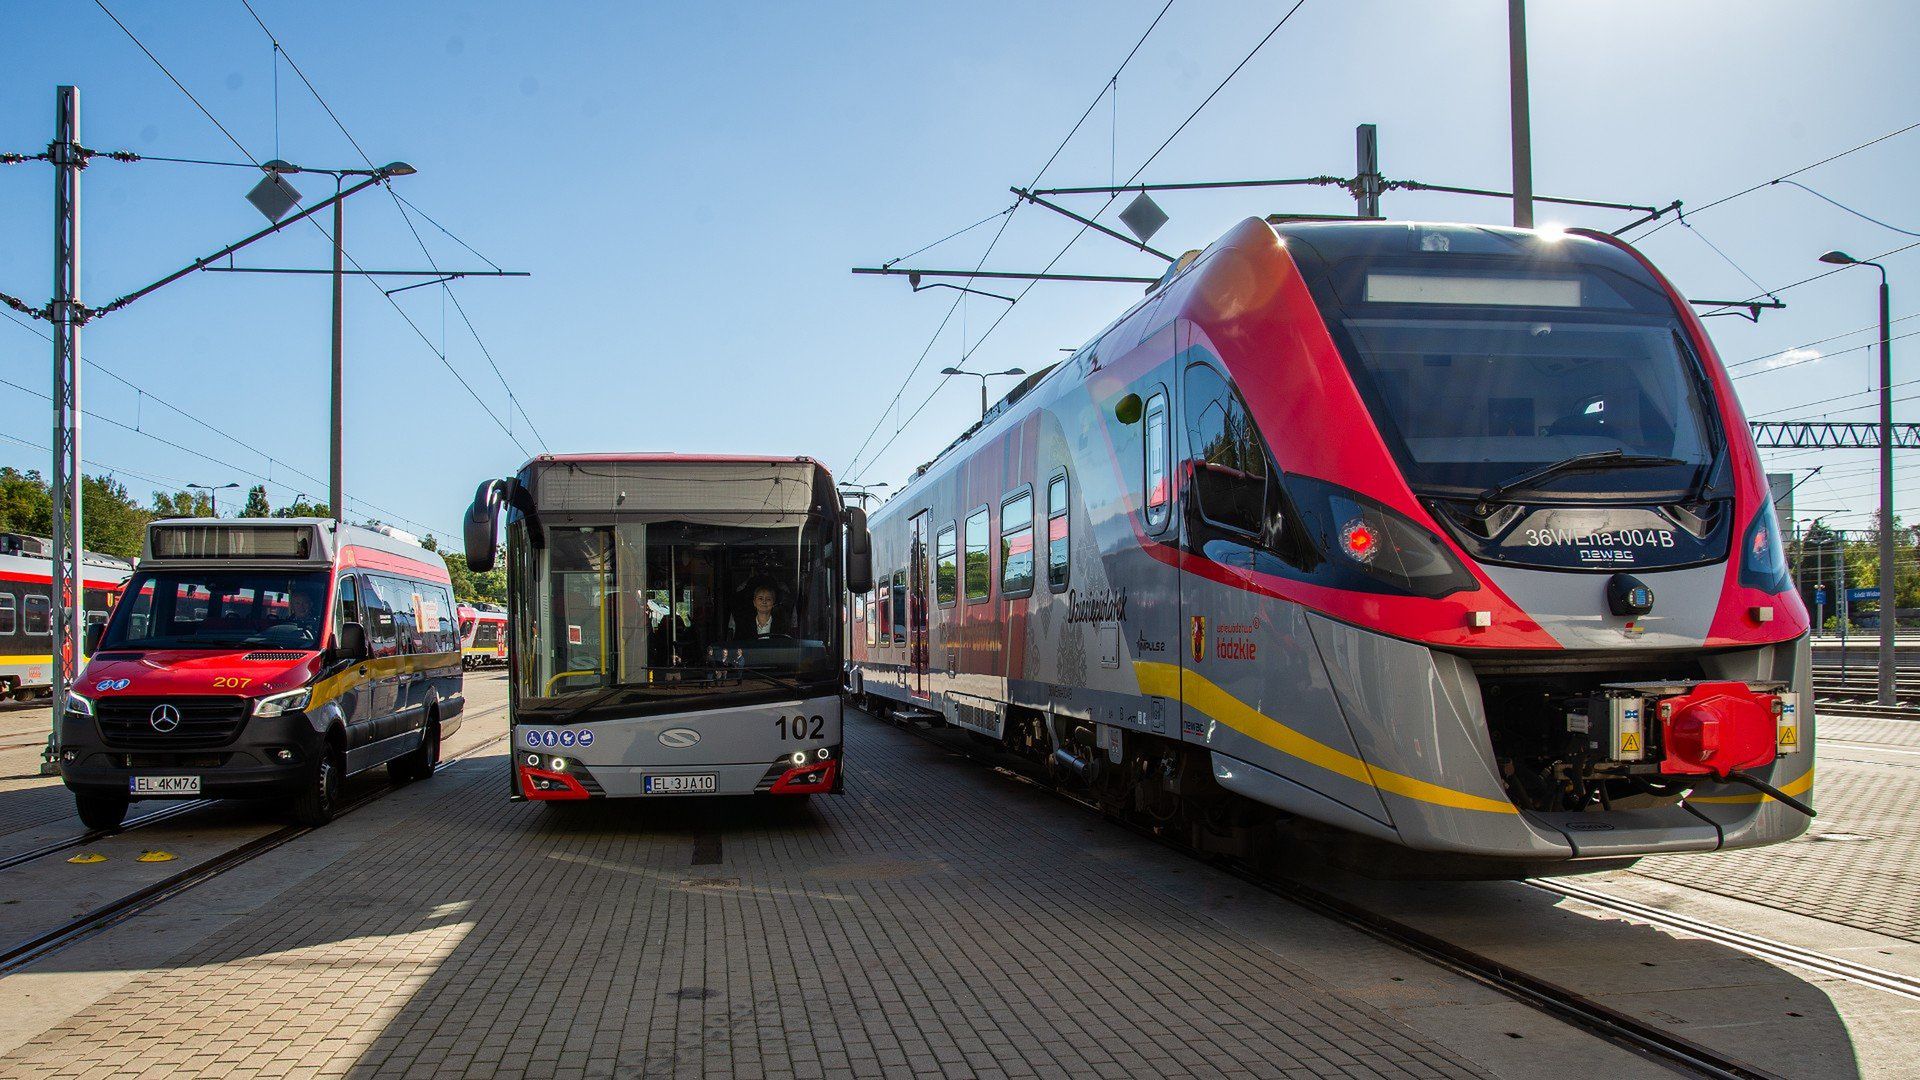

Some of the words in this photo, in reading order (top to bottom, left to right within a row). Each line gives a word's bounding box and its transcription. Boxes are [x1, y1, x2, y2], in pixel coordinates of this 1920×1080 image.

[1525, 528, 1675, 548] 36WEna-004B
[1217, 637, 1257, 660] łódzkie
[213, 676, 252, 689] 207
[775, 715, 825, 740] 102
[138, 778, 153, 790] EL
[159, 778, 198, 790] 4KM76
[653, 777, 669, 790] EL
[674, 777, 713, 790] 3JA10
